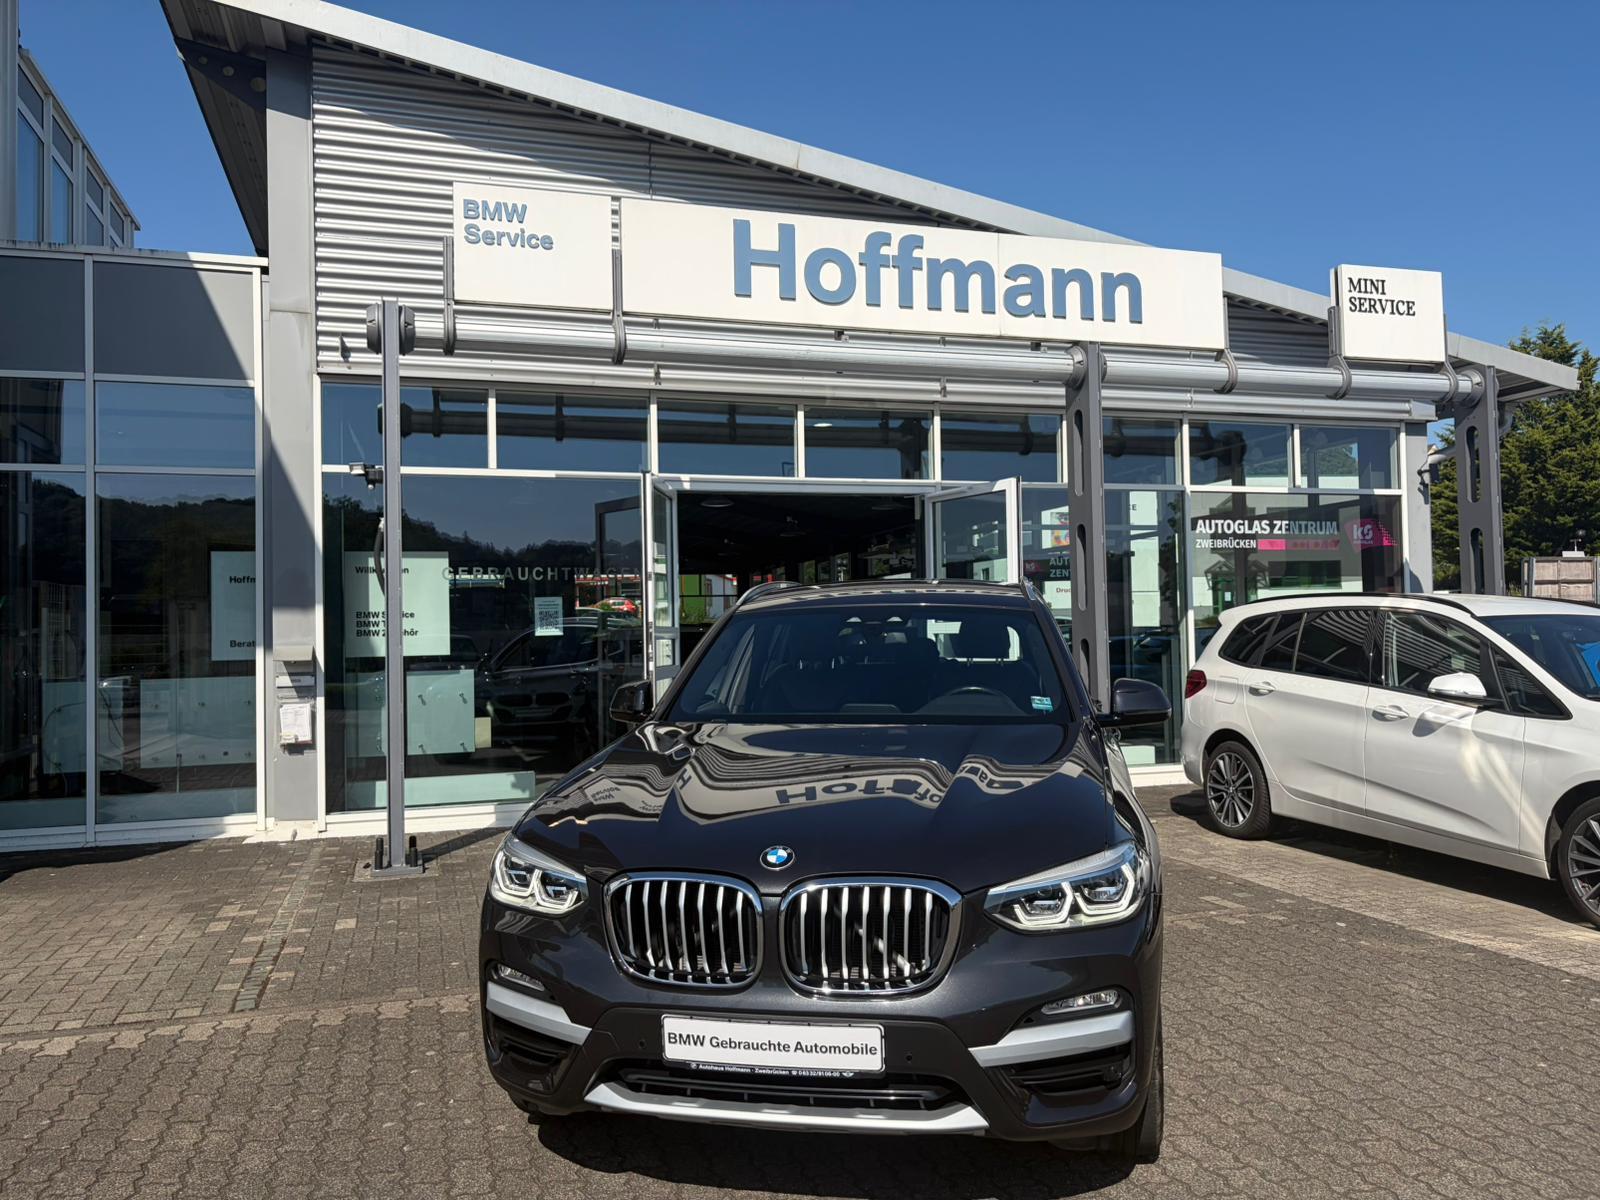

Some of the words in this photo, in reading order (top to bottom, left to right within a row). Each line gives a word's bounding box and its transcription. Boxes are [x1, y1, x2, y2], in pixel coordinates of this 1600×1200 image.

[463, 198, 527, 224] BMW
[464, 223, 554, 250] Service
[733, 218, 1142, 325] Hoffmann
[1347, 277, 1386, 295] MINI
[1349, 296, 1416, 316] SERVICE
[1195, 519, 1270, 535] AUTOGLAS
[1272, 520, 1339, 535] ZENTRUM
[1195, 537, 1257, 549] ZWEIBRÜCKEN
[356, 611, 380, 619] BMW
[356, 620, 380, 628] BMW
[356, 629, 380, 637] BMW
[667, 1032, 706, 1047] BMW
[709, 1036, 791, 1053] Gebrauchte
[793, 1040, 878, 1056] Automobile
